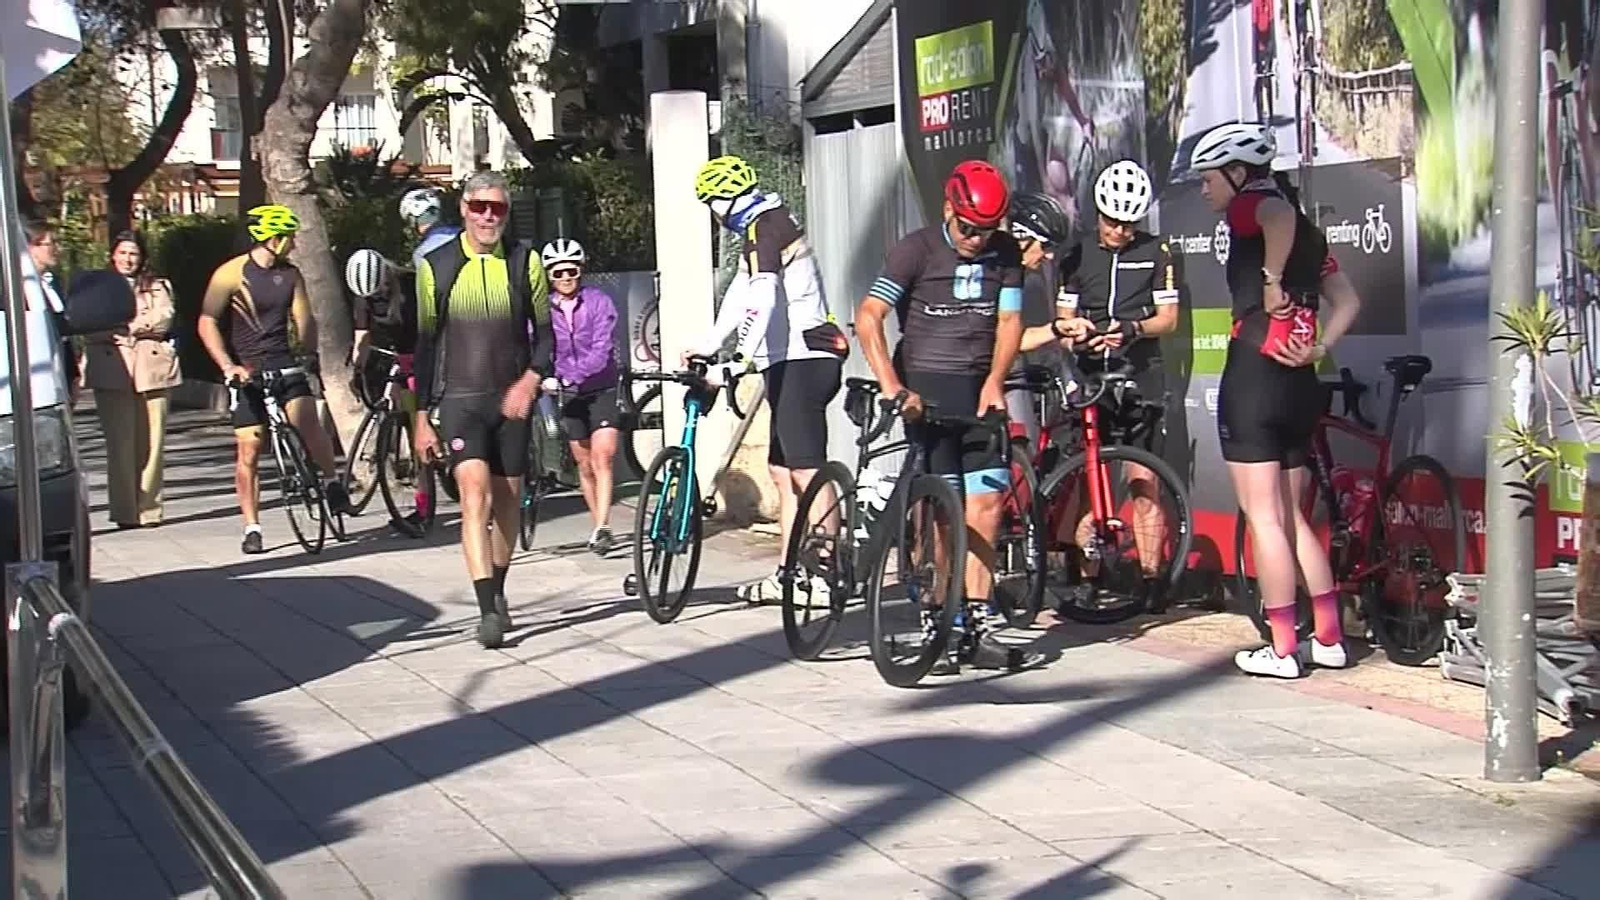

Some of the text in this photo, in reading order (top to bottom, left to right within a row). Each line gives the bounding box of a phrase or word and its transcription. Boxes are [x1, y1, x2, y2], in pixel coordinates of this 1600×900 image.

[922, 87, 990, 127] PRO RENT
[924, 127, 993, 152] mallorca
[1185, 232, 1212, 254] center
[1326, 220, 1360, 248] renting
